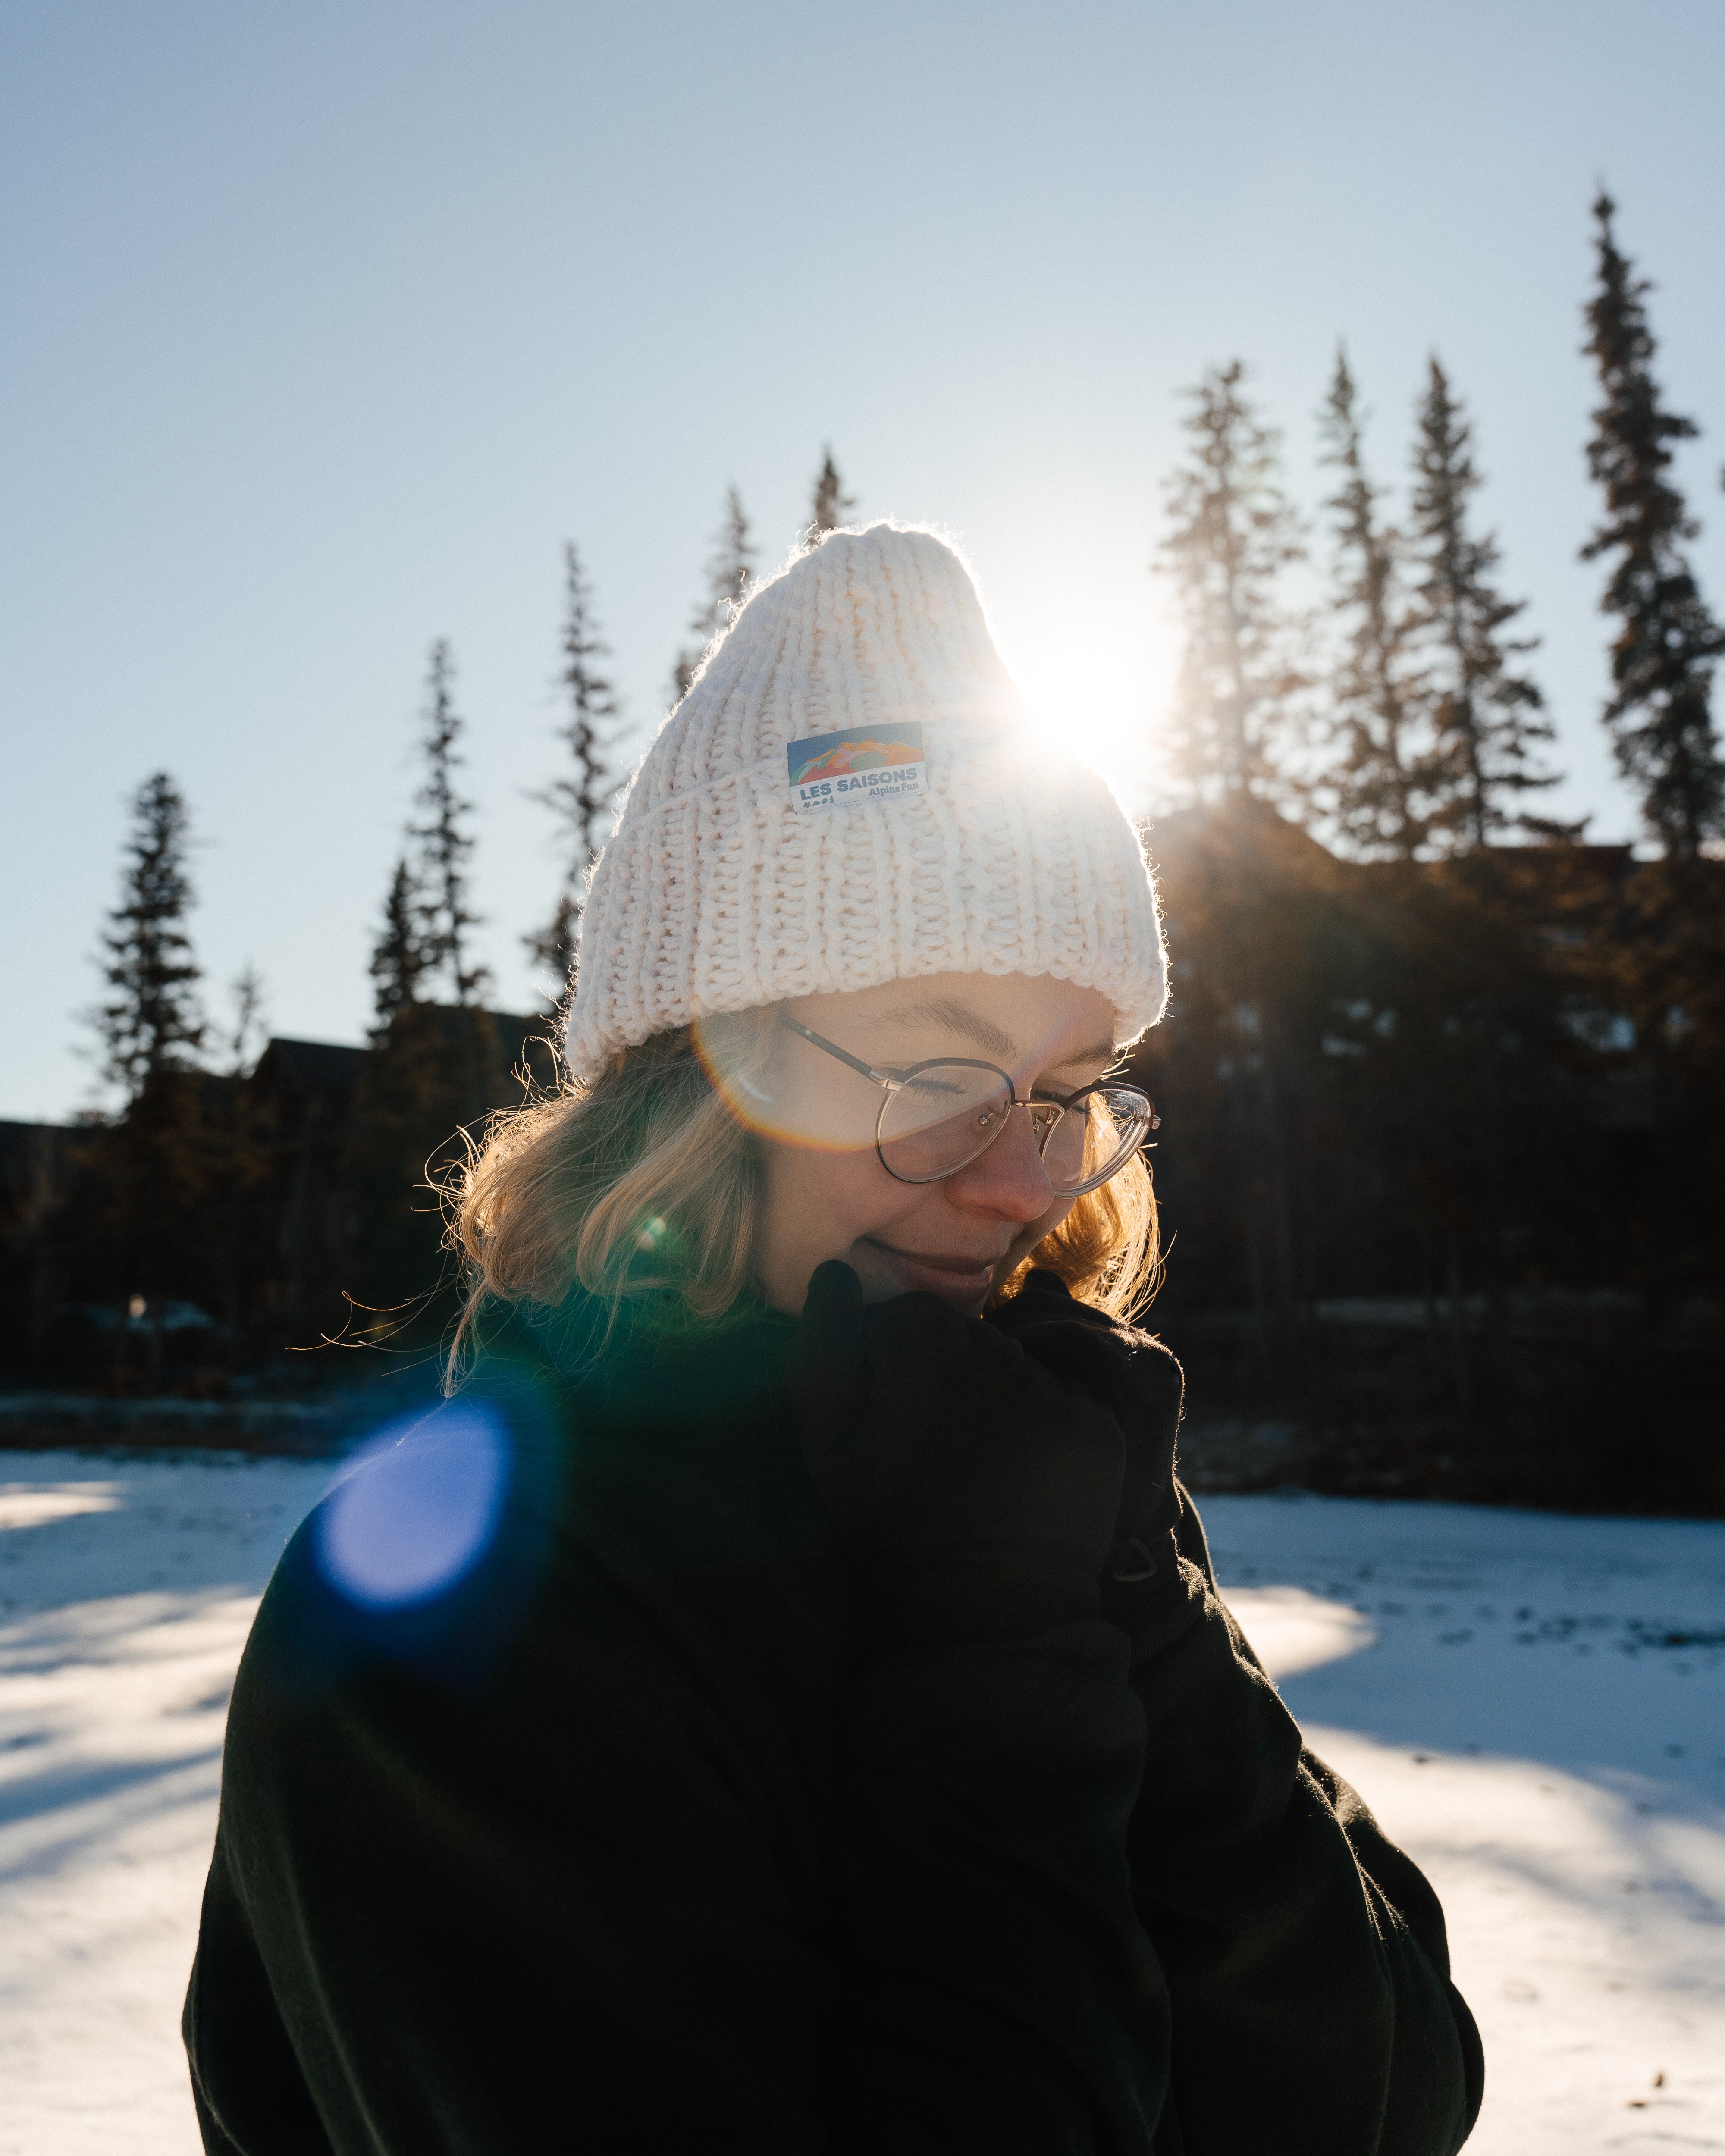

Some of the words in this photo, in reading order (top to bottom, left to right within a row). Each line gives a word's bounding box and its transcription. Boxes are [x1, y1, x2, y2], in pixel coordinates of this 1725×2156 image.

[800, 783, 831, 800] LES
[837, 768, 918, 792] SAISONS
[869, 786, 900, 796] Alpine
[901, 782, 919, 791] Fun
